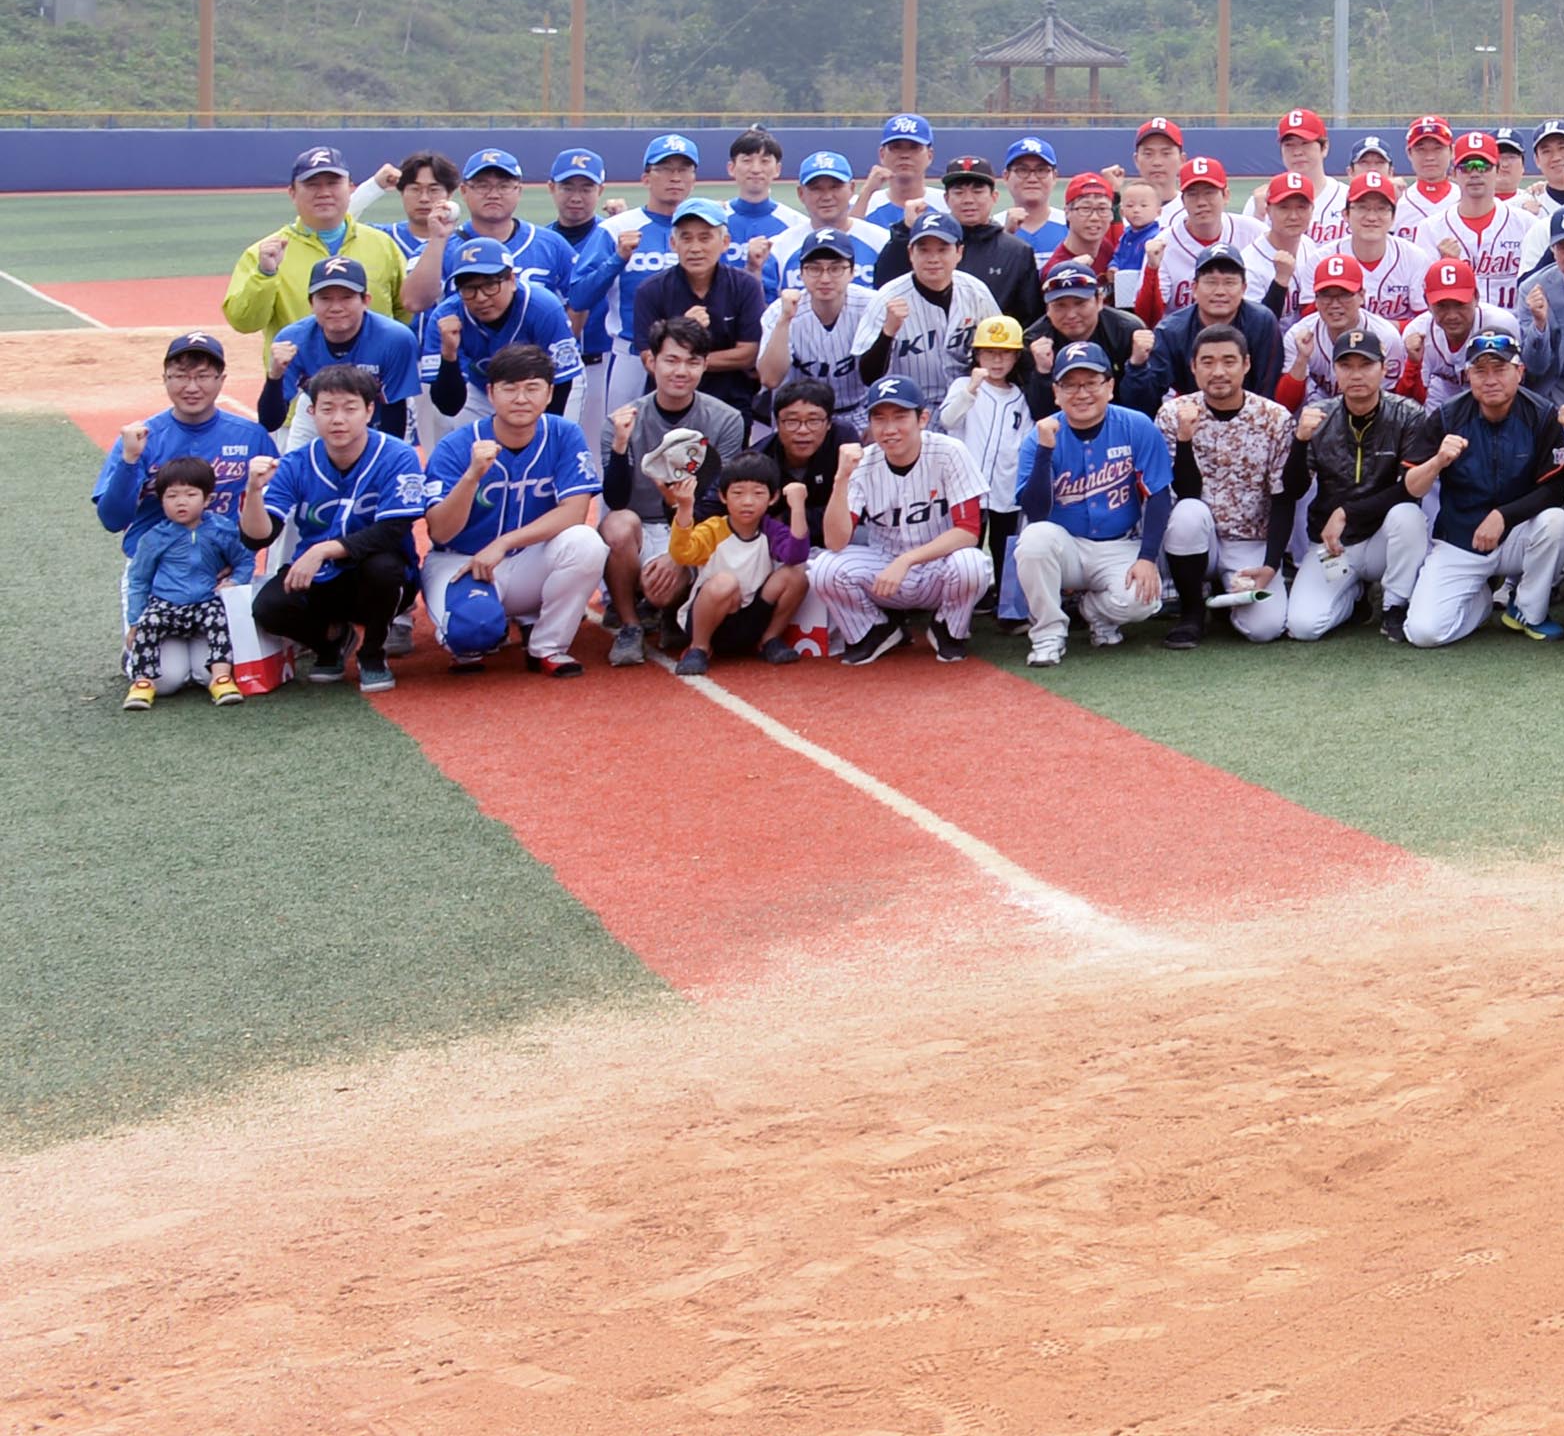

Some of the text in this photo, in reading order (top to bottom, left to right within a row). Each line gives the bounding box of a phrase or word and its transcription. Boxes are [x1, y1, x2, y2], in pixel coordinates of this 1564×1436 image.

[1289, 111, 1302, 126] G
[1468, 132, 1483, 148] G
[1193, 157, 1208, 174] G
[1287, 173, 1302, 189] G
[1366, 172, 1382, 187] G
[1329, 258, 1344, 276] G
[1441, 266, 1456, 285] G
[1499, 287, 1514, 308] 11
[1350, 333, 1364, 347] P
[1012, 411, 1023, 430] D
[1054, 456, 1133, 498] Thunders
[1108, 485, 1130, 510] 26
